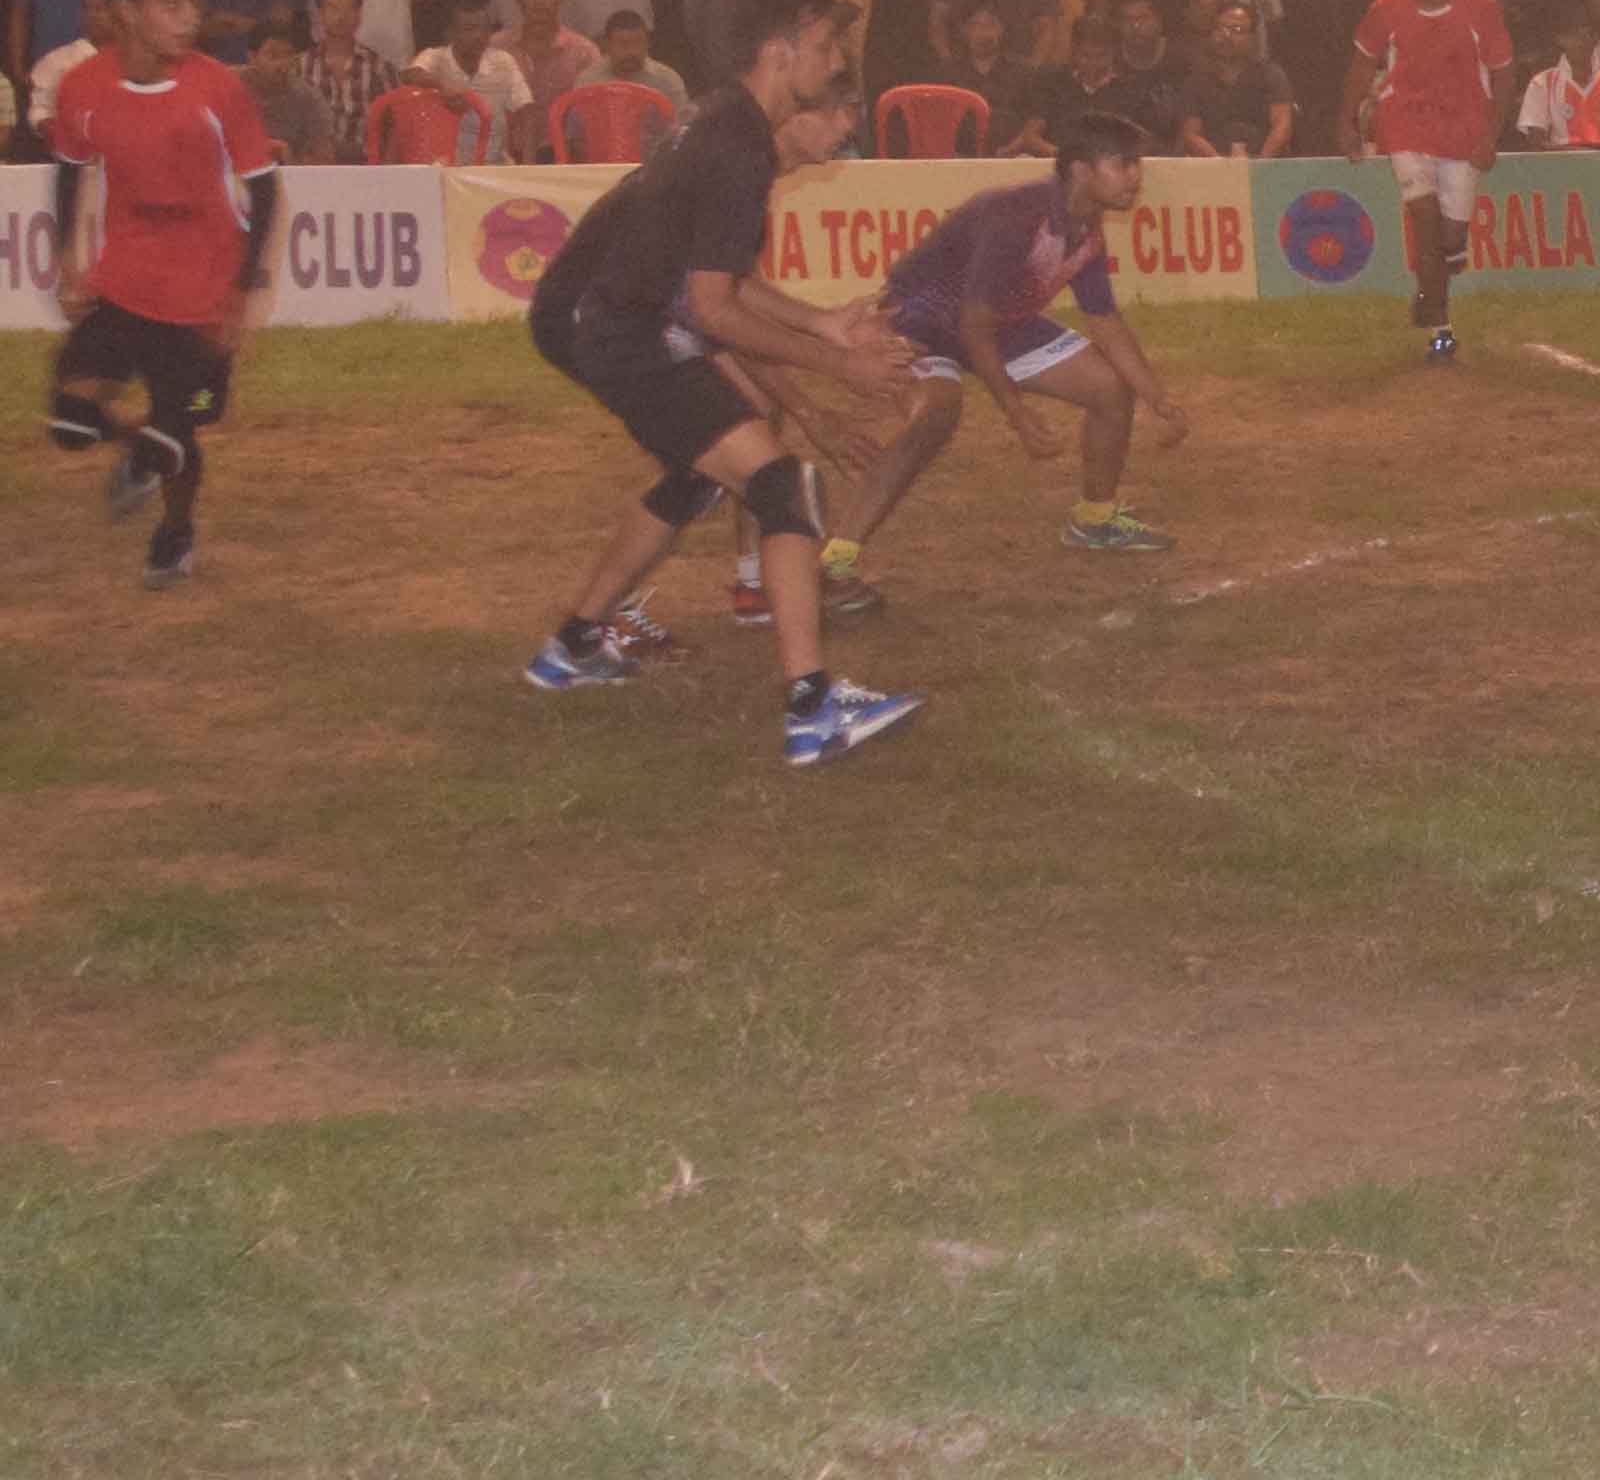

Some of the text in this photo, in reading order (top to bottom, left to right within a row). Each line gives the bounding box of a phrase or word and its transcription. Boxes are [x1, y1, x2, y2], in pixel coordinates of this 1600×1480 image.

[289, 210, 422, 289] CLUB
[1132, 205, 1244, 274] CLUB
[1404, 192, 1595, 271] RALA
